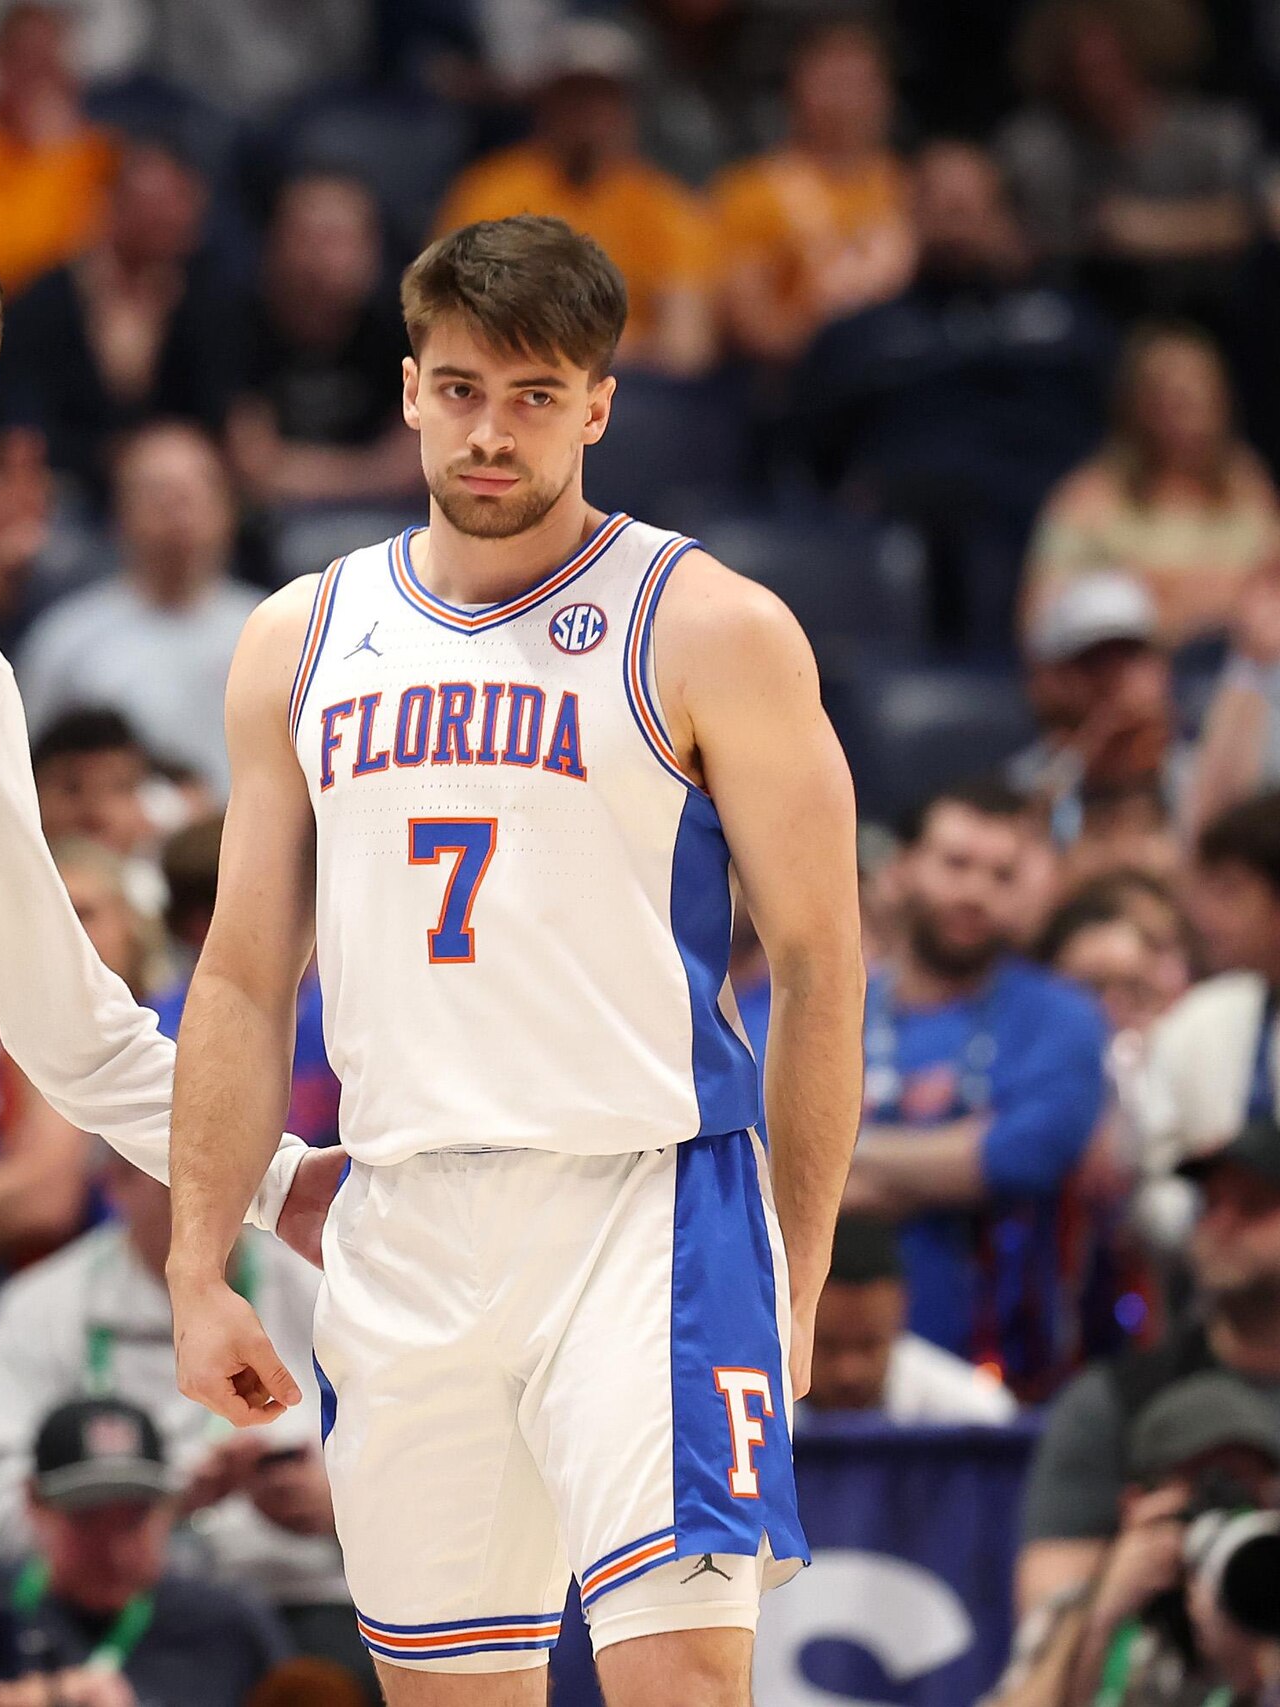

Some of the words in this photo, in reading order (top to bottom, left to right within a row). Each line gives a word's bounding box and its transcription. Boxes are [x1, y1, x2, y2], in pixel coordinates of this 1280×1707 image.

[553, 605, 603, 651] SEC
[320, 682, 587, 793] FLORIDA
[408, 817, 498, 964] 7
[713, 1366, 775, 1499] F
